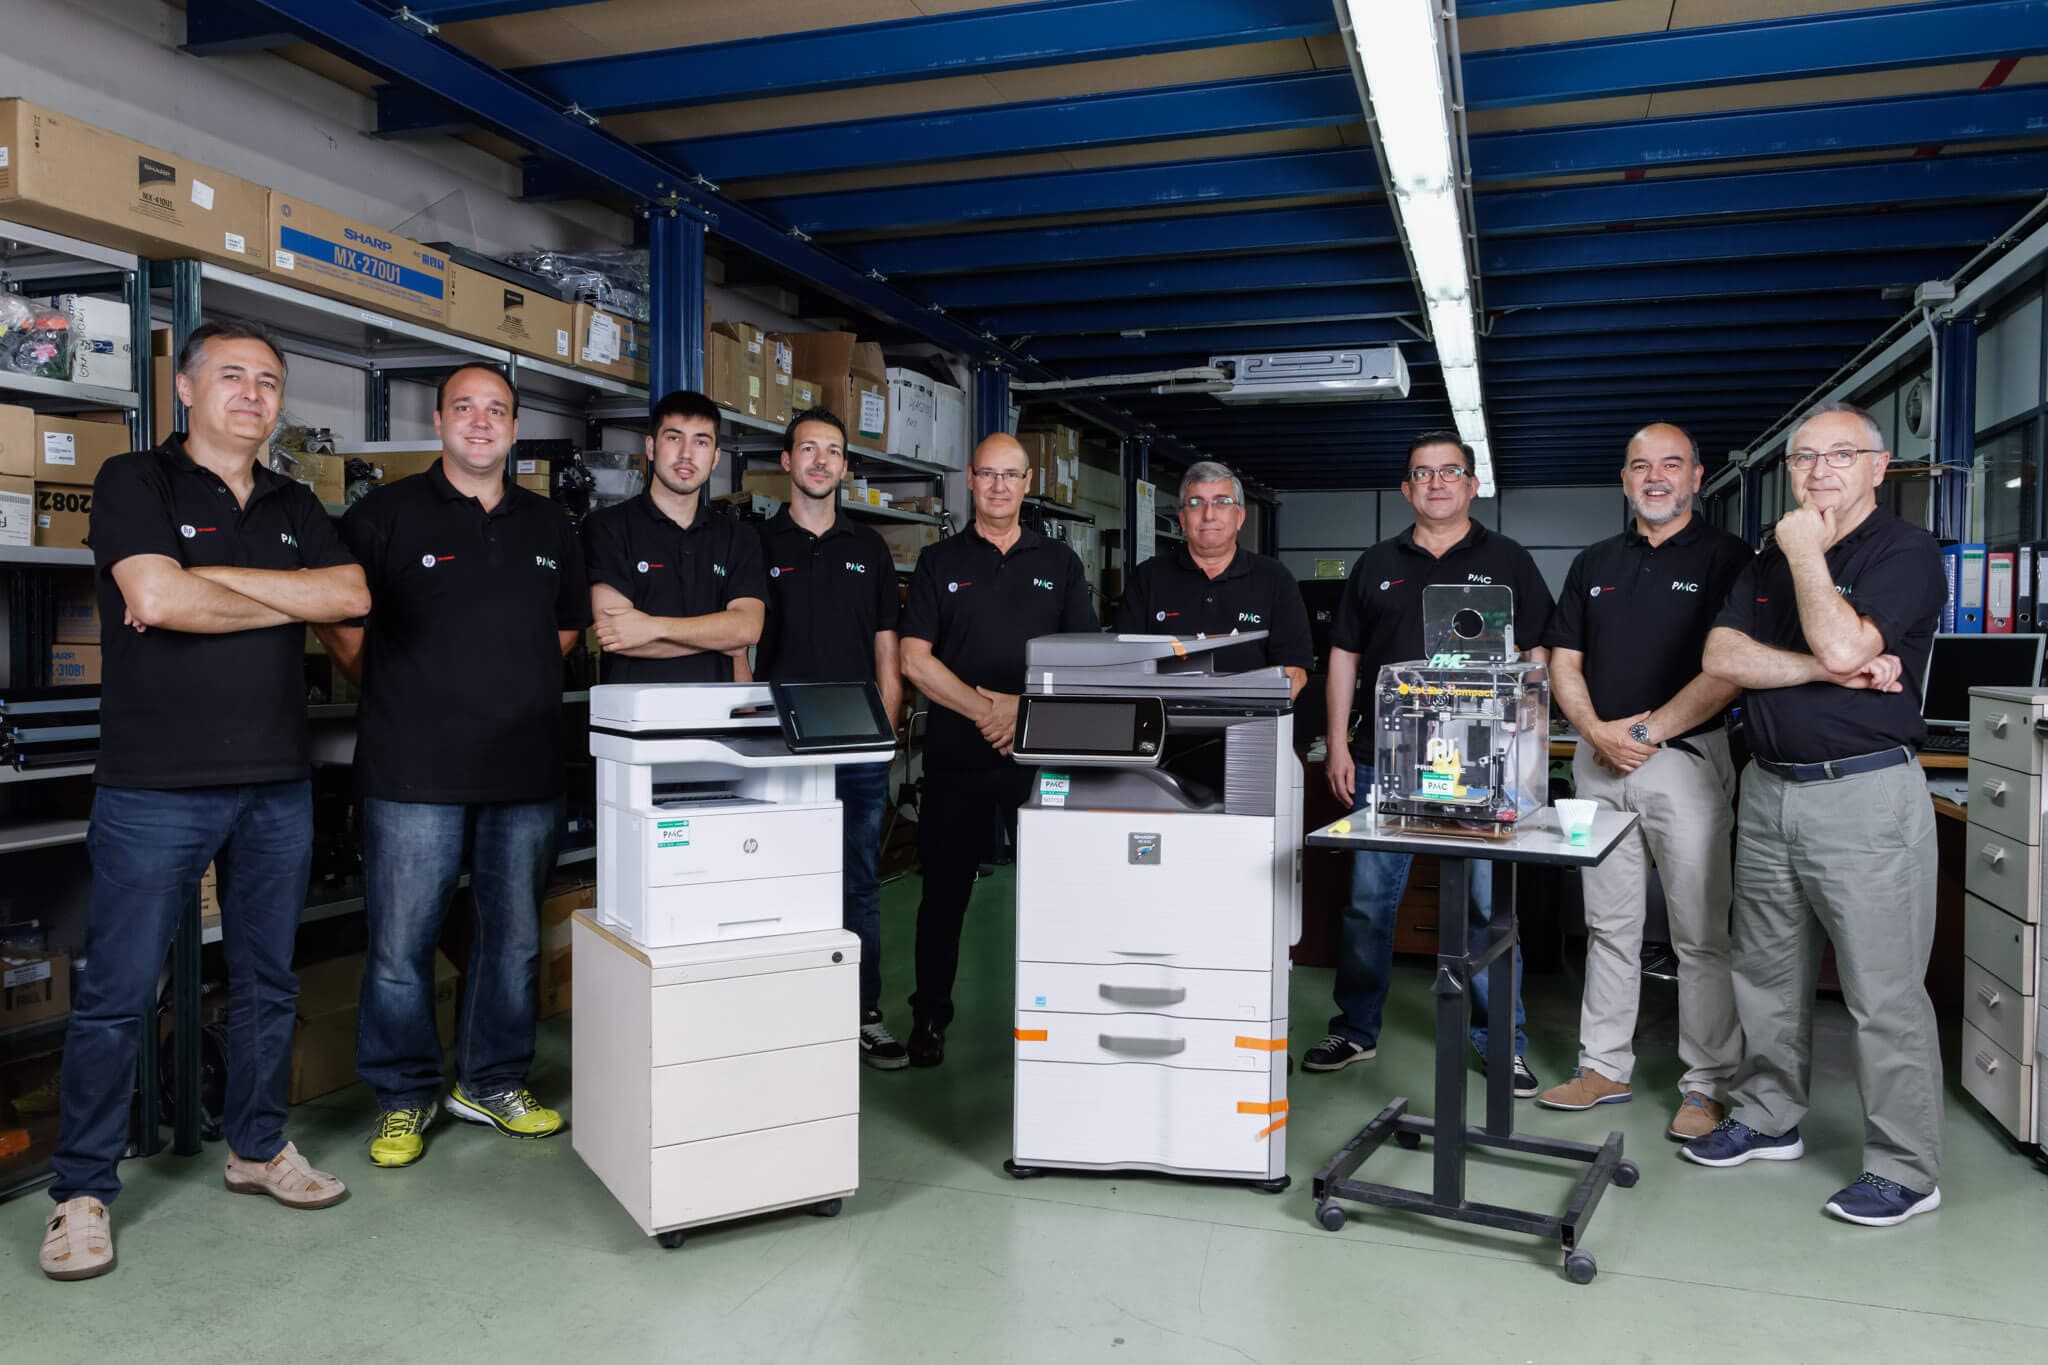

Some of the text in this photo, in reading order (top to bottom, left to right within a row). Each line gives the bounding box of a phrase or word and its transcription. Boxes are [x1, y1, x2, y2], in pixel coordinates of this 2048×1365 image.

[344, 227, 393, 252] SHARP
[334, 246, 401, 284] MX-270U1
[846, 561, 865, 573] PMC
[1033, 578, 1053, 590] PMC
[1467, 573, 1492, 585] PMC
[1671, 581, 1698, 592] PMC
[1239, 612, 1261, 624] PMC
[1428, 653, 1471, 669] PMC
[1427, 782, 1448, 791] PMC
[663, 829, 684, 839] PMC
